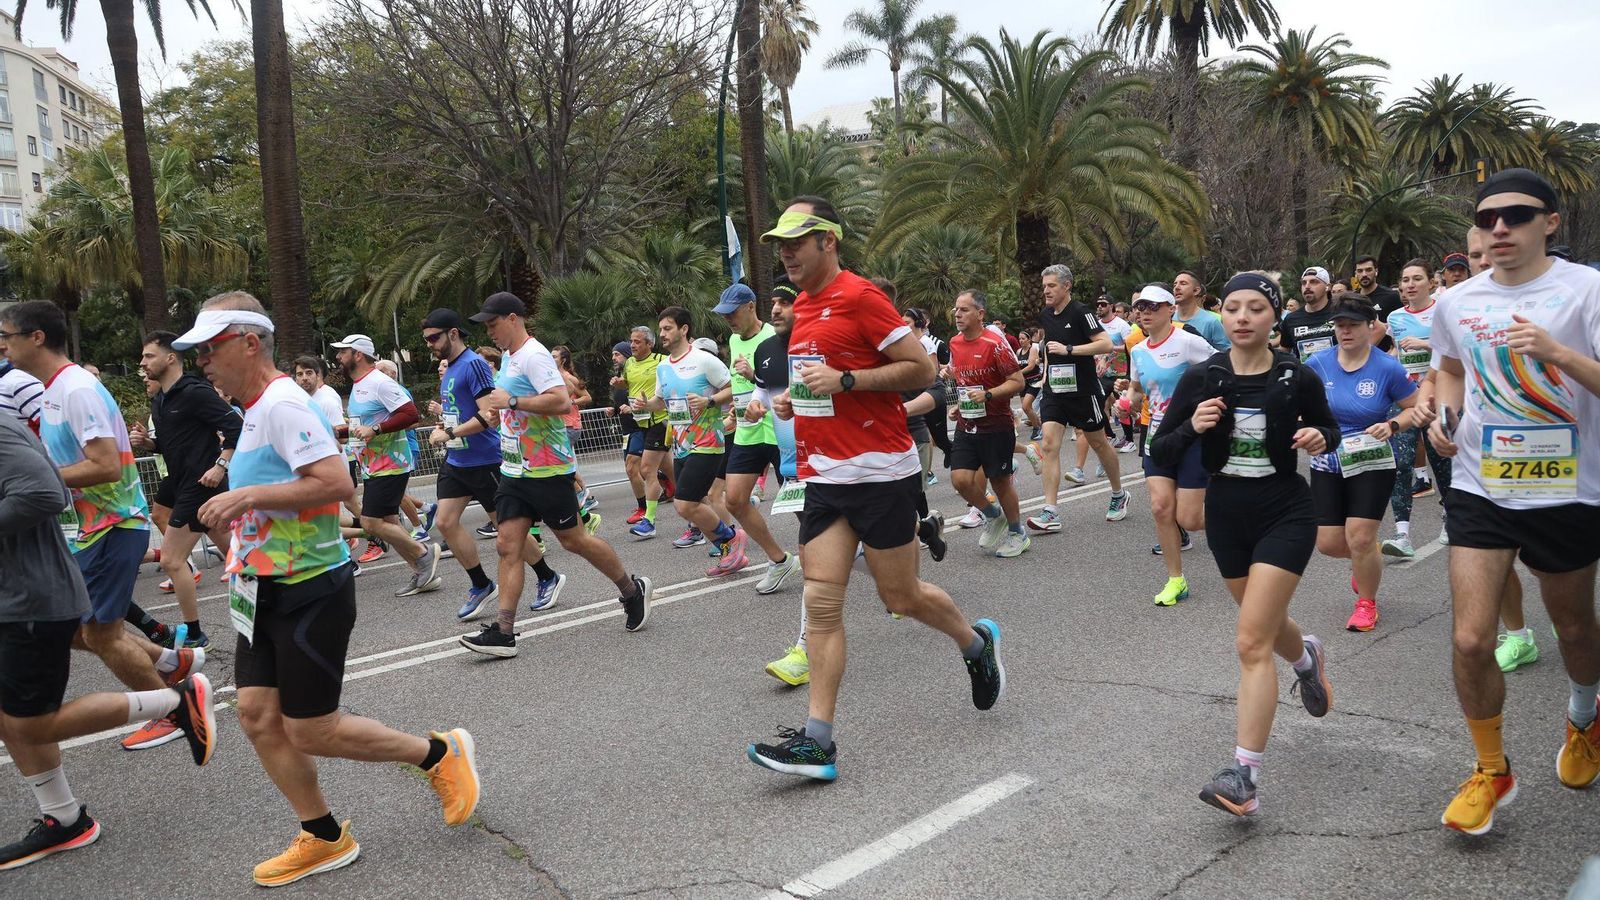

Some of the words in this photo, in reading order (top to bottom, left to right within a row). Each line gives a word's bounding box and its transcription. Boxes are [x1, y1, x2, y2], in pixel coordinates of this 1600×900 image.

[1404, 353, 1429, 364] 6207
[1351, 448, 1385, 463] 5638
[1499, 460, 1560, 479] 2746
[781, 488, 806, 501] 3907
